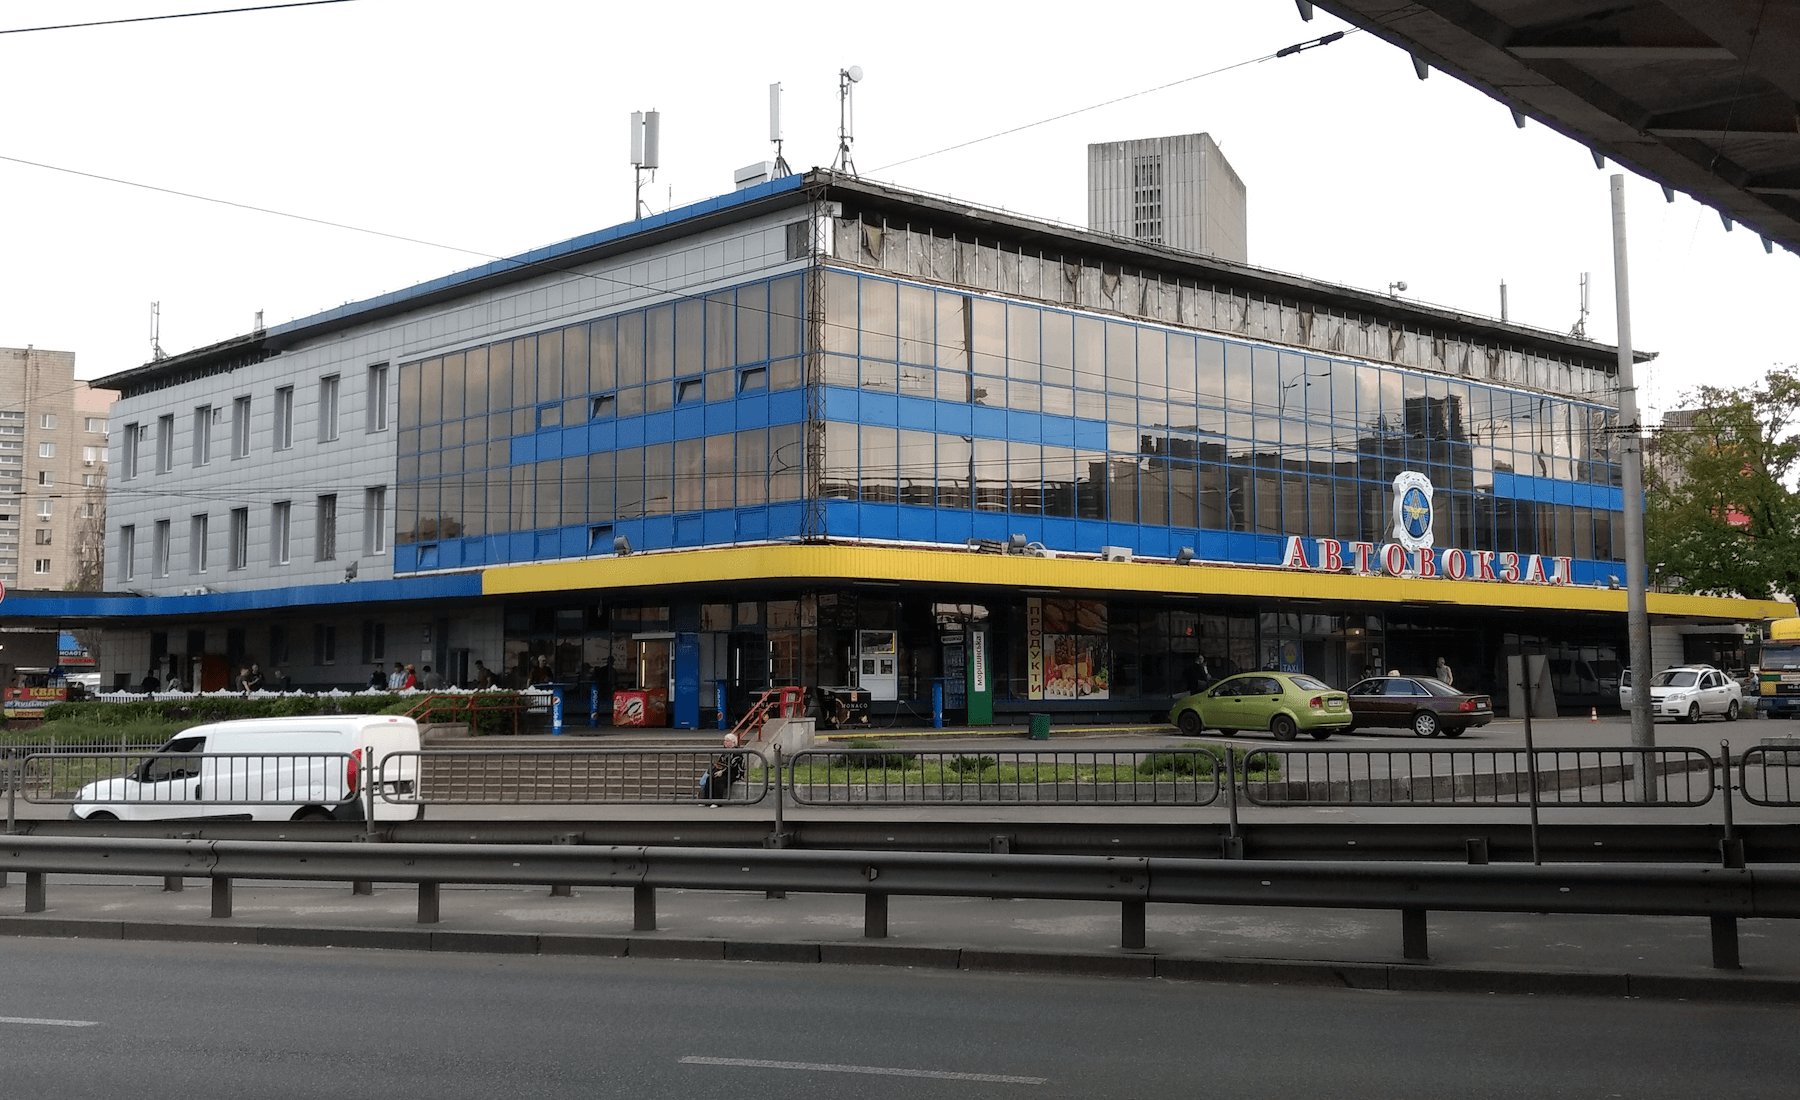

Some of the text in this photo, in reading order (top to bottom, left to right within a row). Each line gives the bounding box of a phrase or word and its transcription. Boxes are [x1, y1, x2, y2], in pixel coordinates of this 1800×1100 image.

[1284, 535, 1573, 585] АВТОВОКЗАЛ
[1030, 606, 1041, 692] ПРОДУКТИ
[1283, 664, 1299, 672] TAXI
[30, 688, 63, 697] КВАС
